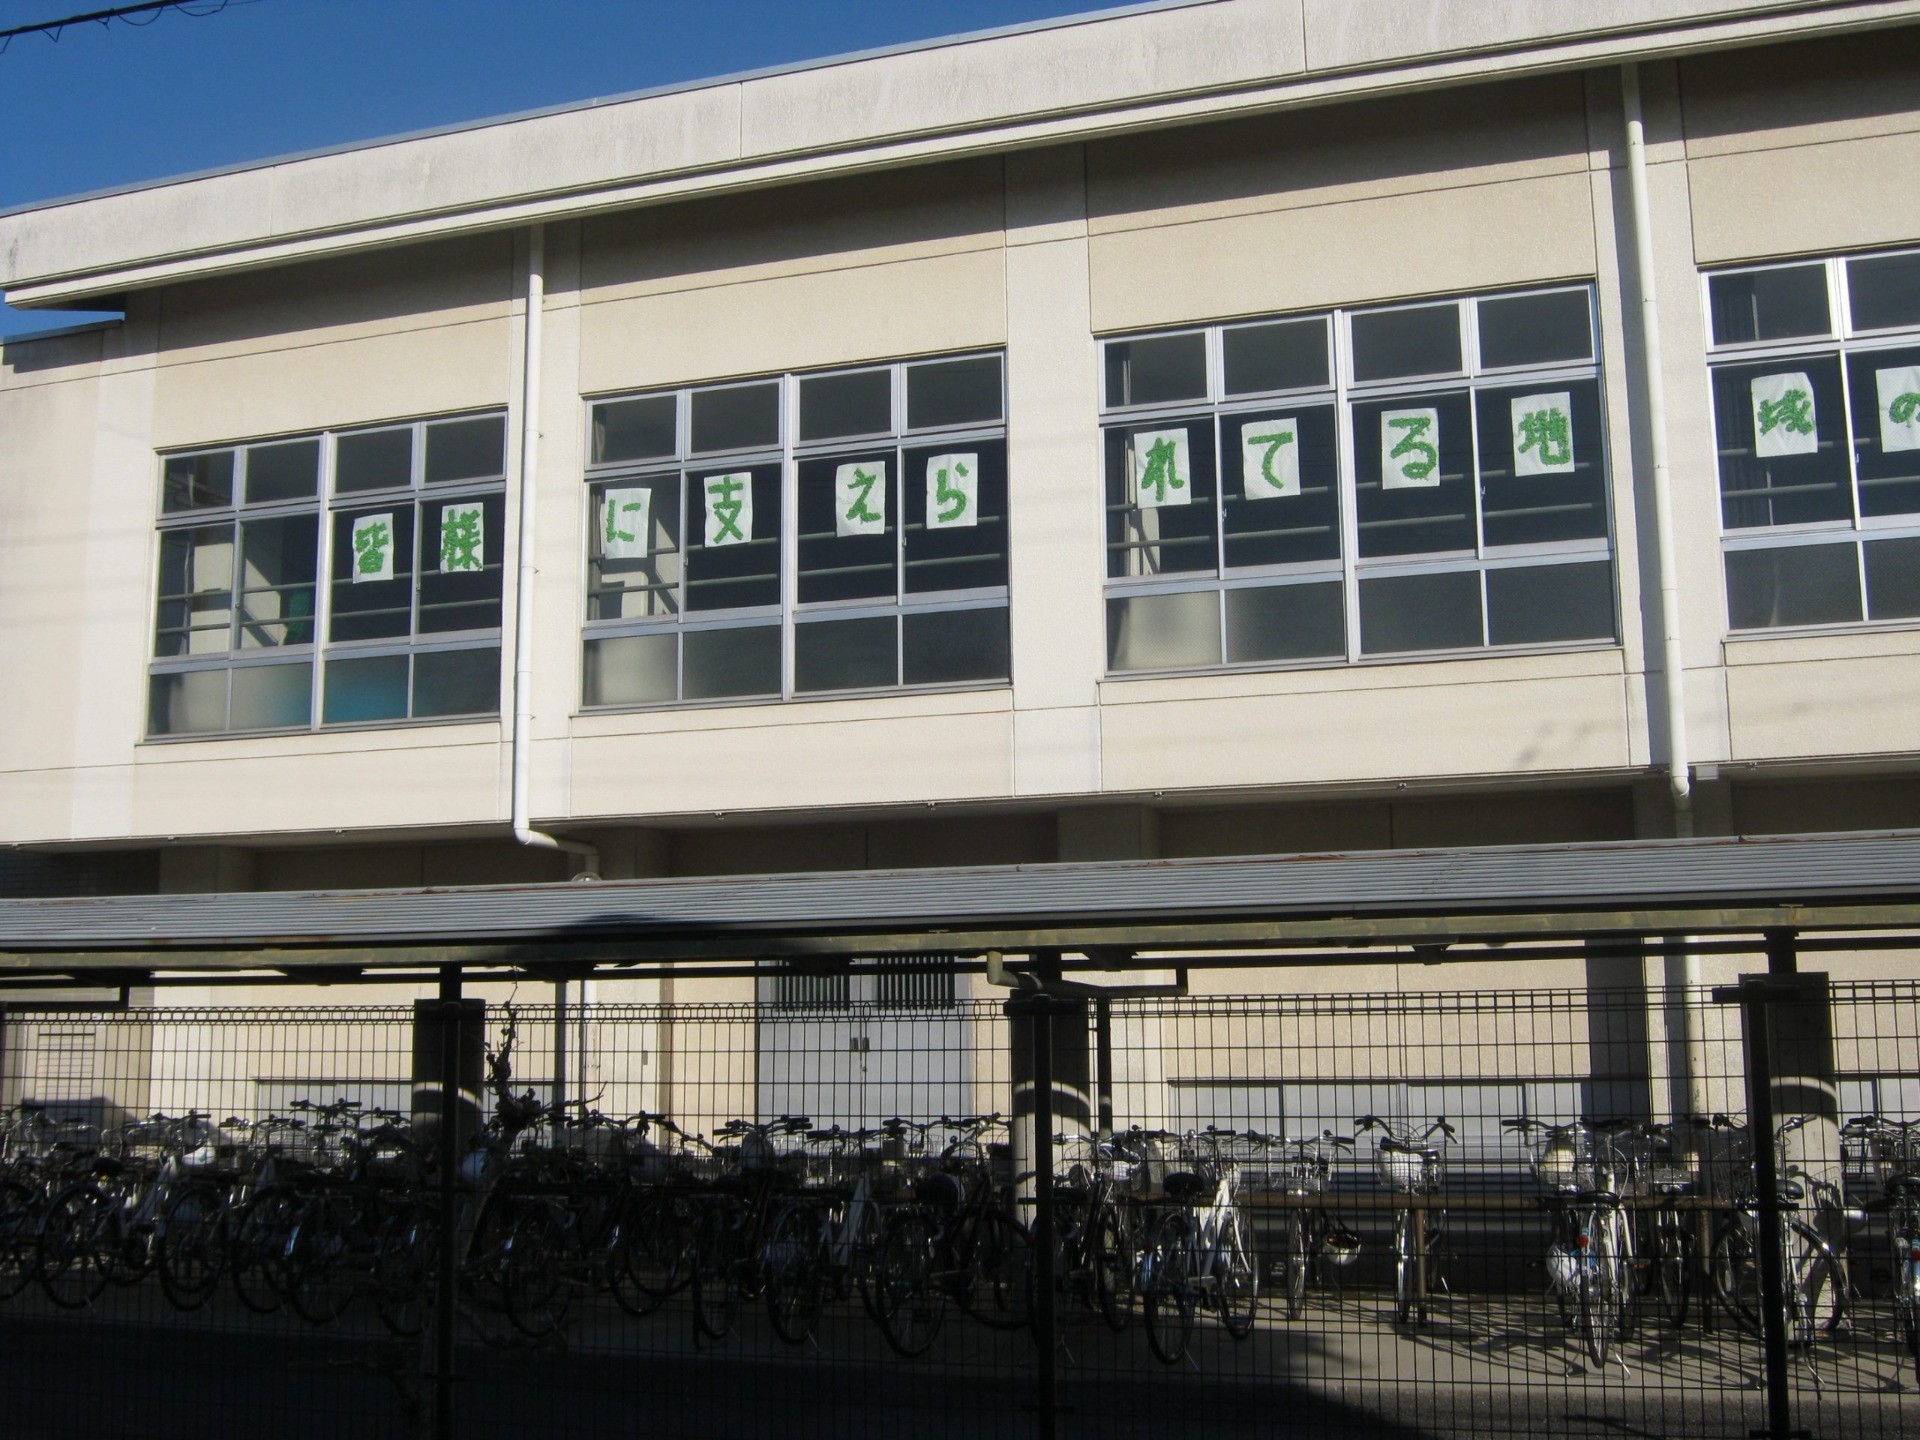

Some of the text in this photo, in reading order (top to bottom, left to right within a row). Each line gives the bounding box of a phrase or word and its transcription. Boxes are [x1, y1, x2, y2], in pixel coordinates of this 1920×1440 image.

[605, 498, 642, 543] に
[707, 474, 744, 543] 支
[847, 467, 881, 524] え
[935, 461, 970, 523] ら
[1140, 436, 1185, 502] れ
[1248, 430, 1294, 489] て
[1390, 416, 1438, 480] る
